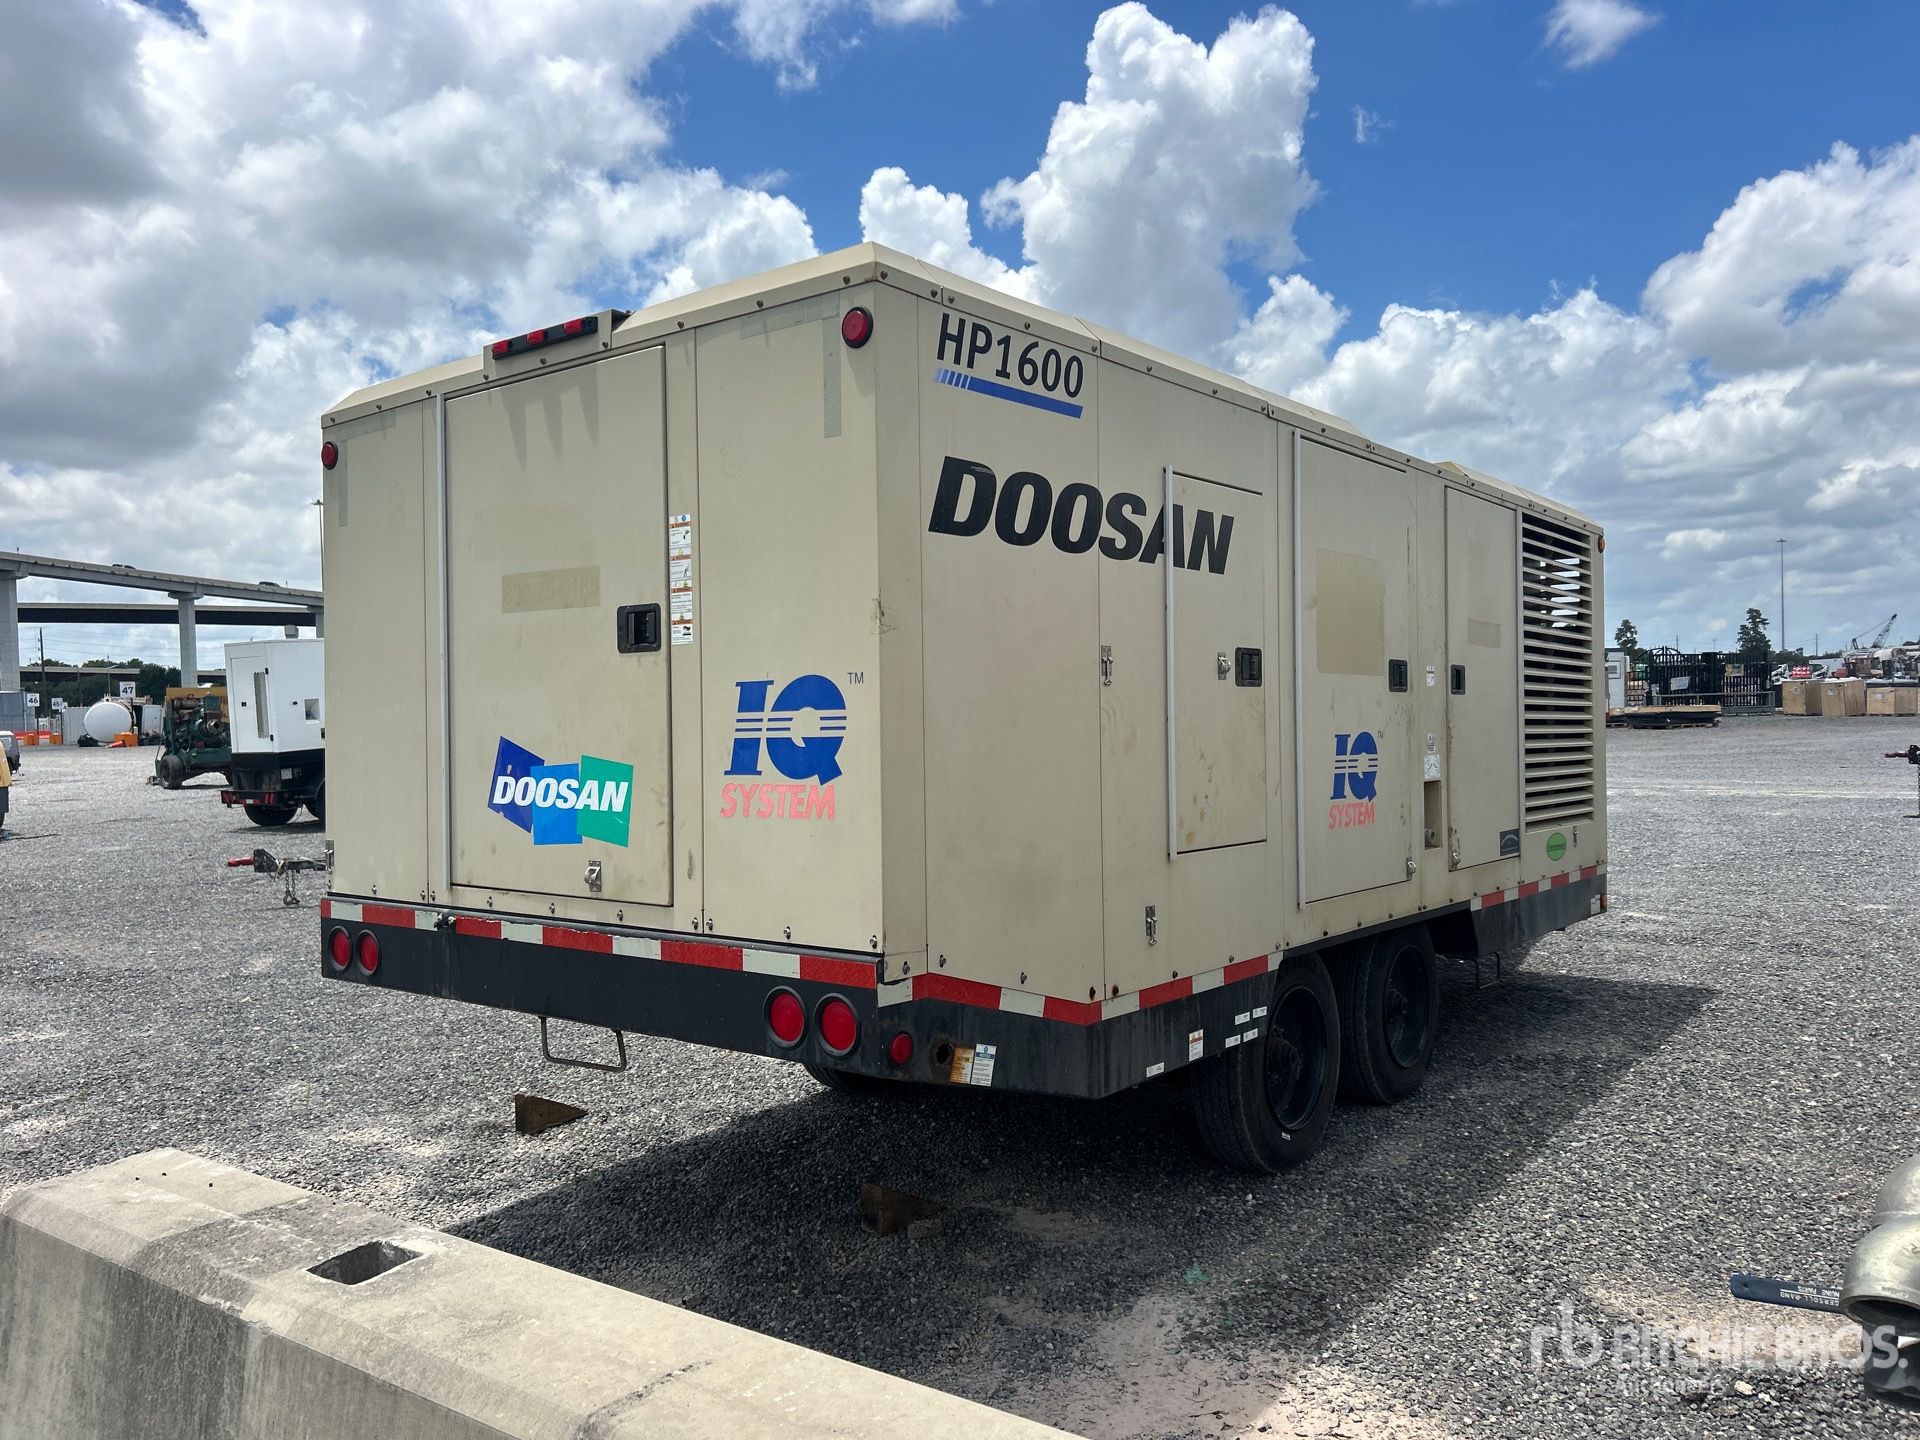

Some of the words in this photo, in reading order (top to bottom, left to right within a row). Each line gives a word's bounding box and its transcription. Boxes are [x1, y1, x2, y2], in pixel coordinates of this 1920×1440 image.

[937, 312, 1084, 398] HP1600
[928, 455, 1235, 575] DOOSAN
[122, 687, 134, 695] 47
[723, 674, 847, 786] IQ
[1330, 731, 1378, 802] IQ
[492, 775, 629, 813] DOOSAN
[719, 782, 836, 821] SYSTEM
[1328, 801, 1375, 830] SYSTEM
[1780, 1291, 1840, 1307] GERSOLL-RAND
[1798, 1285, 1817, 1294] PARTS
[1822, 1289, 1840, 1297] NUINE
